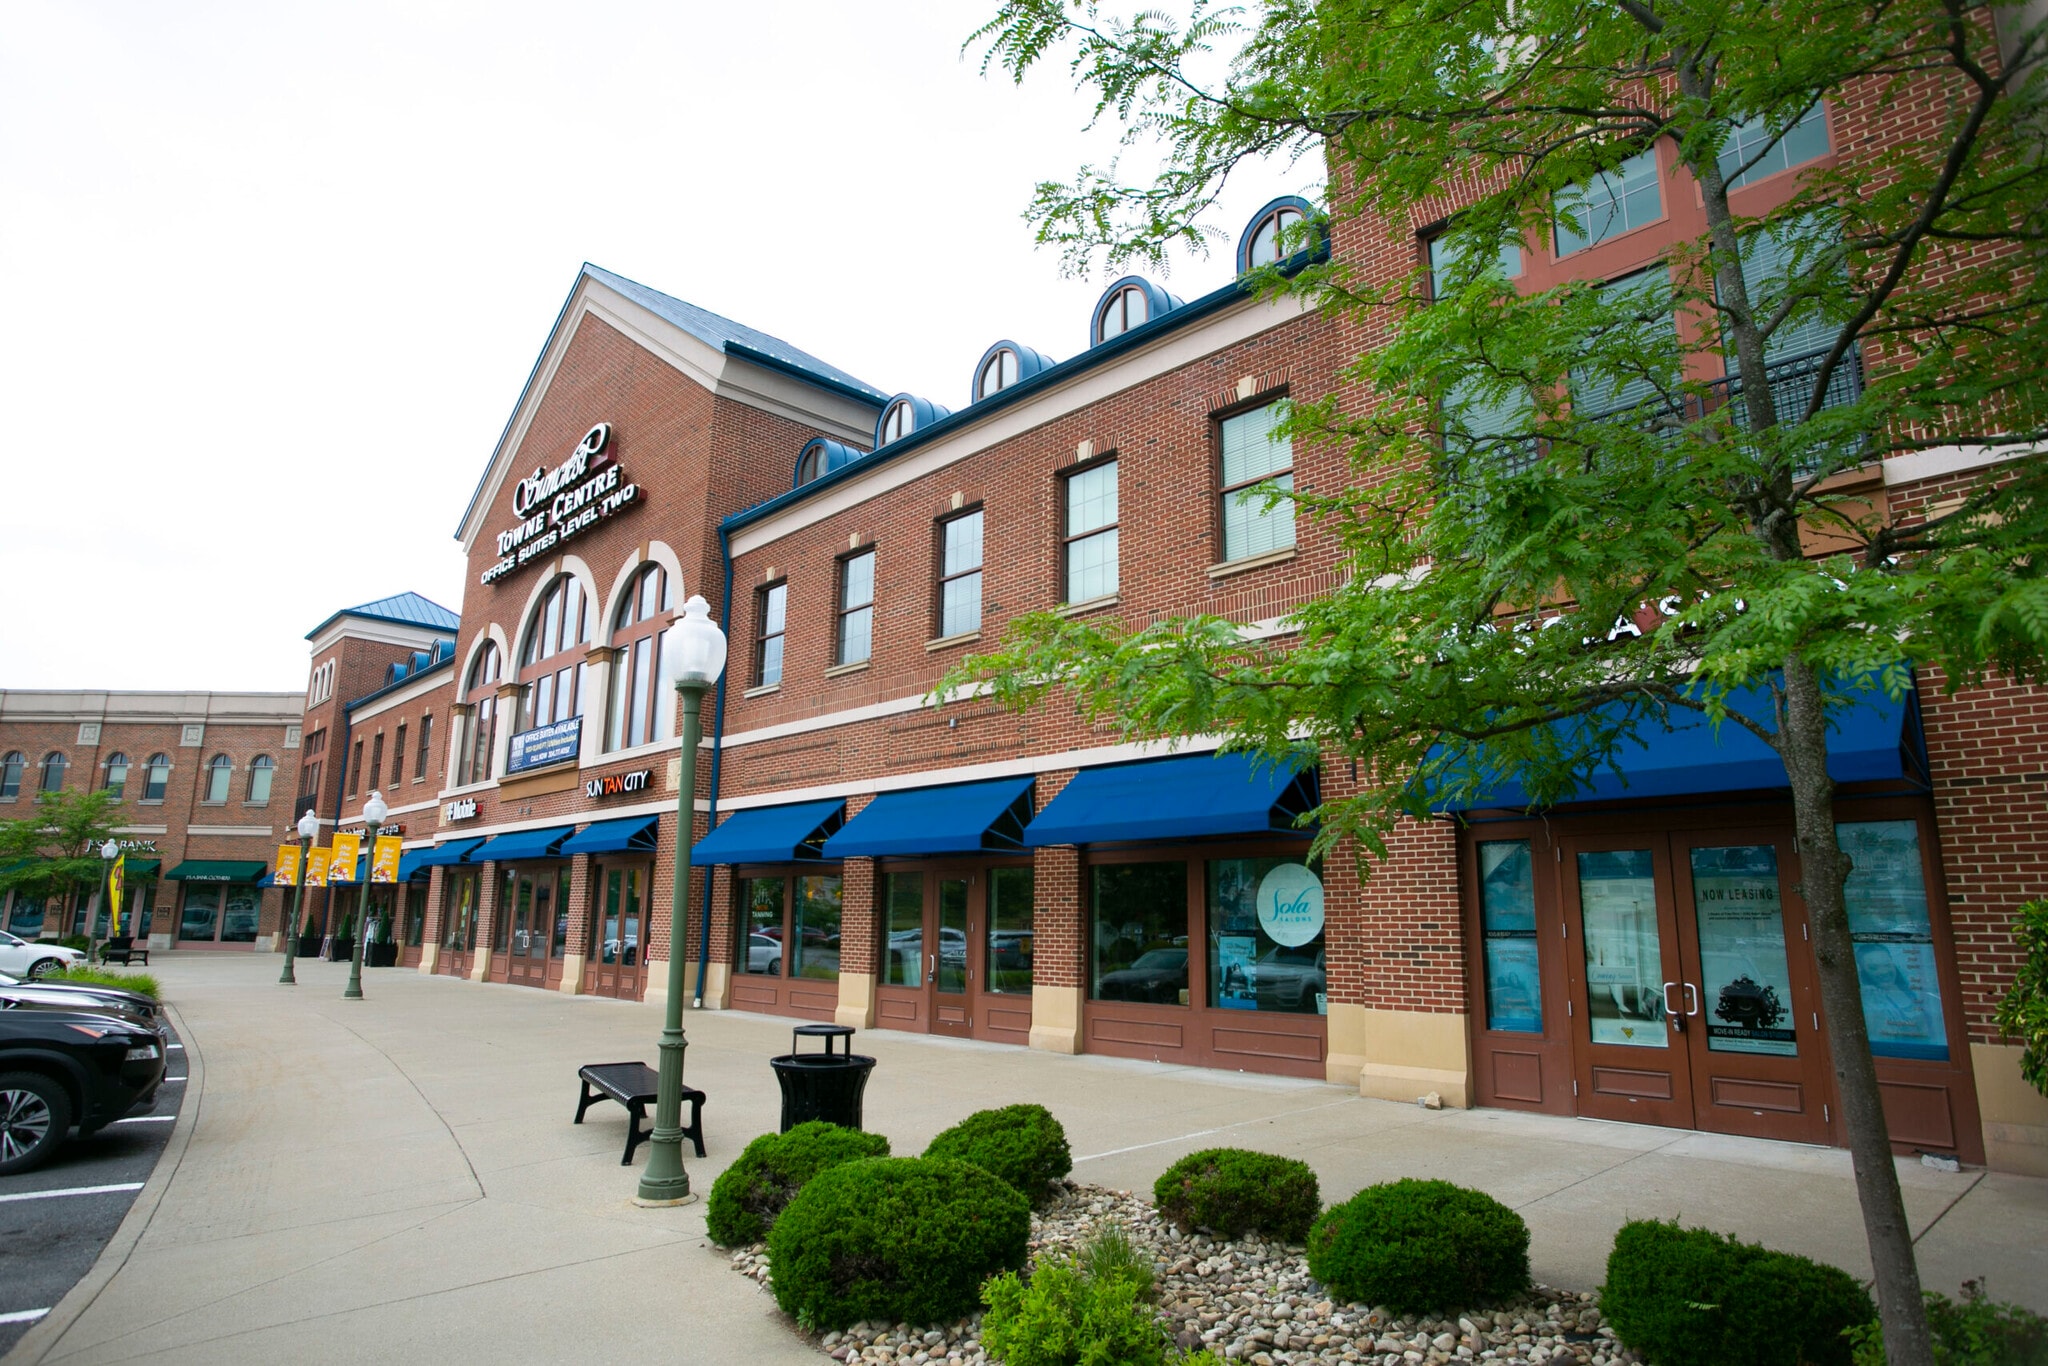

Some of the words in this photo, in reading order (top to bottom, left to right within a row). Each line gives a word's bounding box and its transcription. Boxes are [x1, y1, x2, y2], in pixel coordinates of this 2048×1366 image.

[513, 423, 607, 518] Suncrest
[481, 555, 515, 584] OFFICE
[518, 530, 557, 563] SUITES
[560, 507, 598, 539] LEVEL
[602, 484, 635, 514] TWO
[496, 511, 545, 557] TOWNE
[552, 464, 619, 521] CENTRE
[586, 779, 603, 798] SUN
[604, 775, 624, 795] TAN
[624, 770, 648, 791] CITY
[1263, 886, 1320, 922] Sola
[1702, 888, 1724, 900] NOW
[1729, 888, 1774, 900] LEASING
